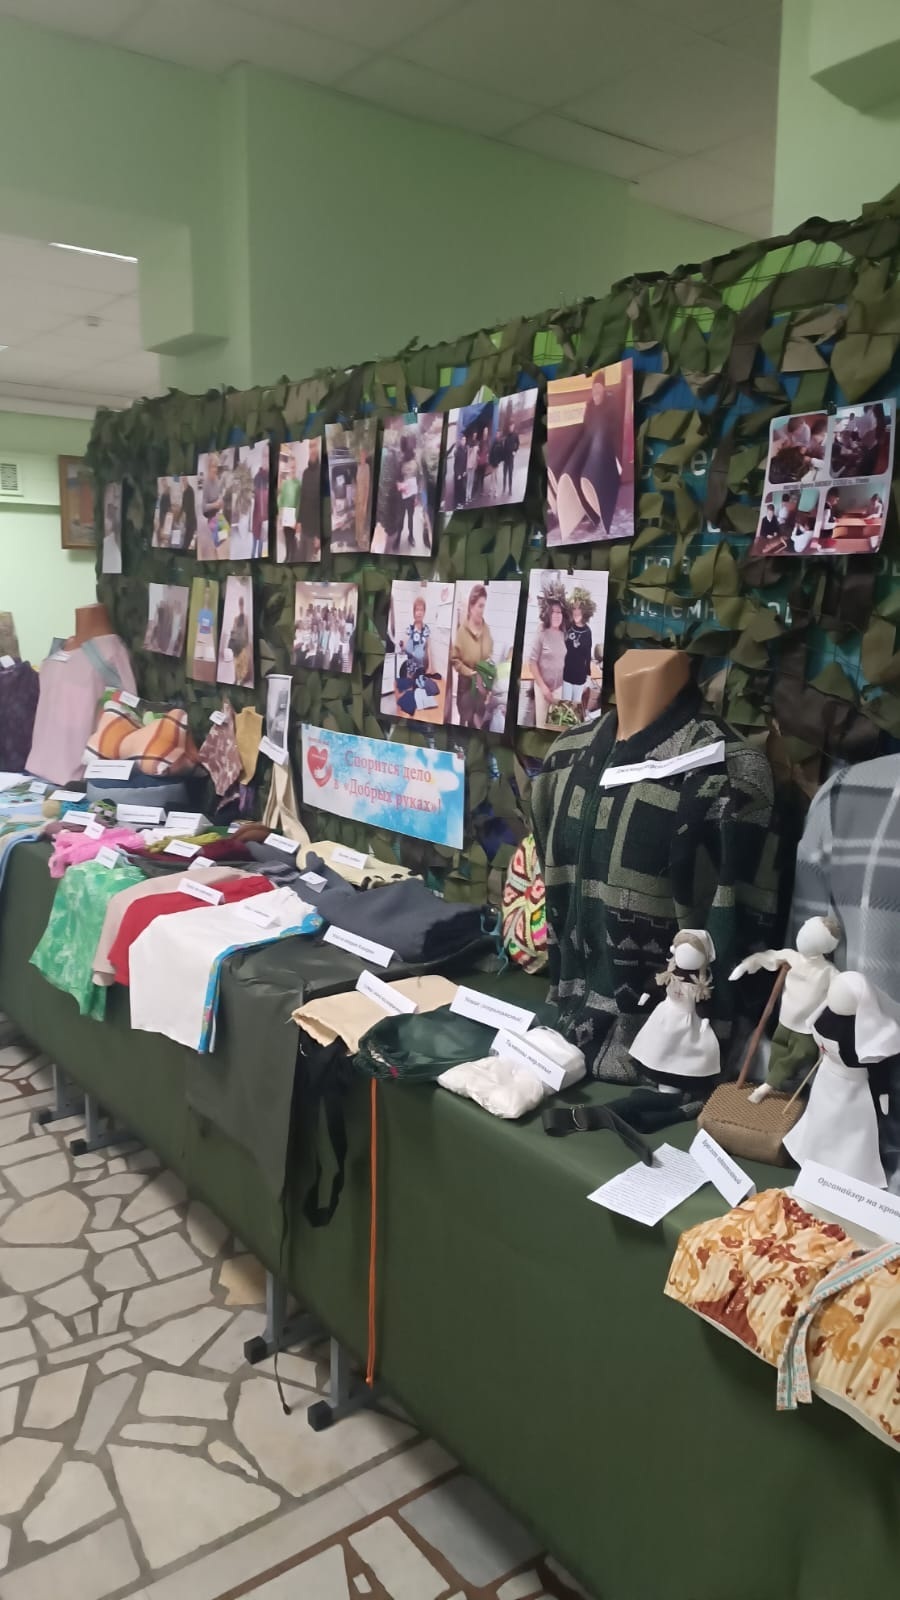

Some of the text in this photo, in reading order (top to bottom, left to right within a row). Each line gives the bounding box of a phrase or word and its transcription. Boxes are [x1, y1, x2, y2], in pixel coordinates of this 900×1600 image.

[344, 750, 432, 783] Спорится дело
[344, 778, 393, 804] «Добрых
[396, 794, 441, 814] руках»!
[818, 1177, 865, 1203] Органайзер
[866, 1199, 878, 1207] на
